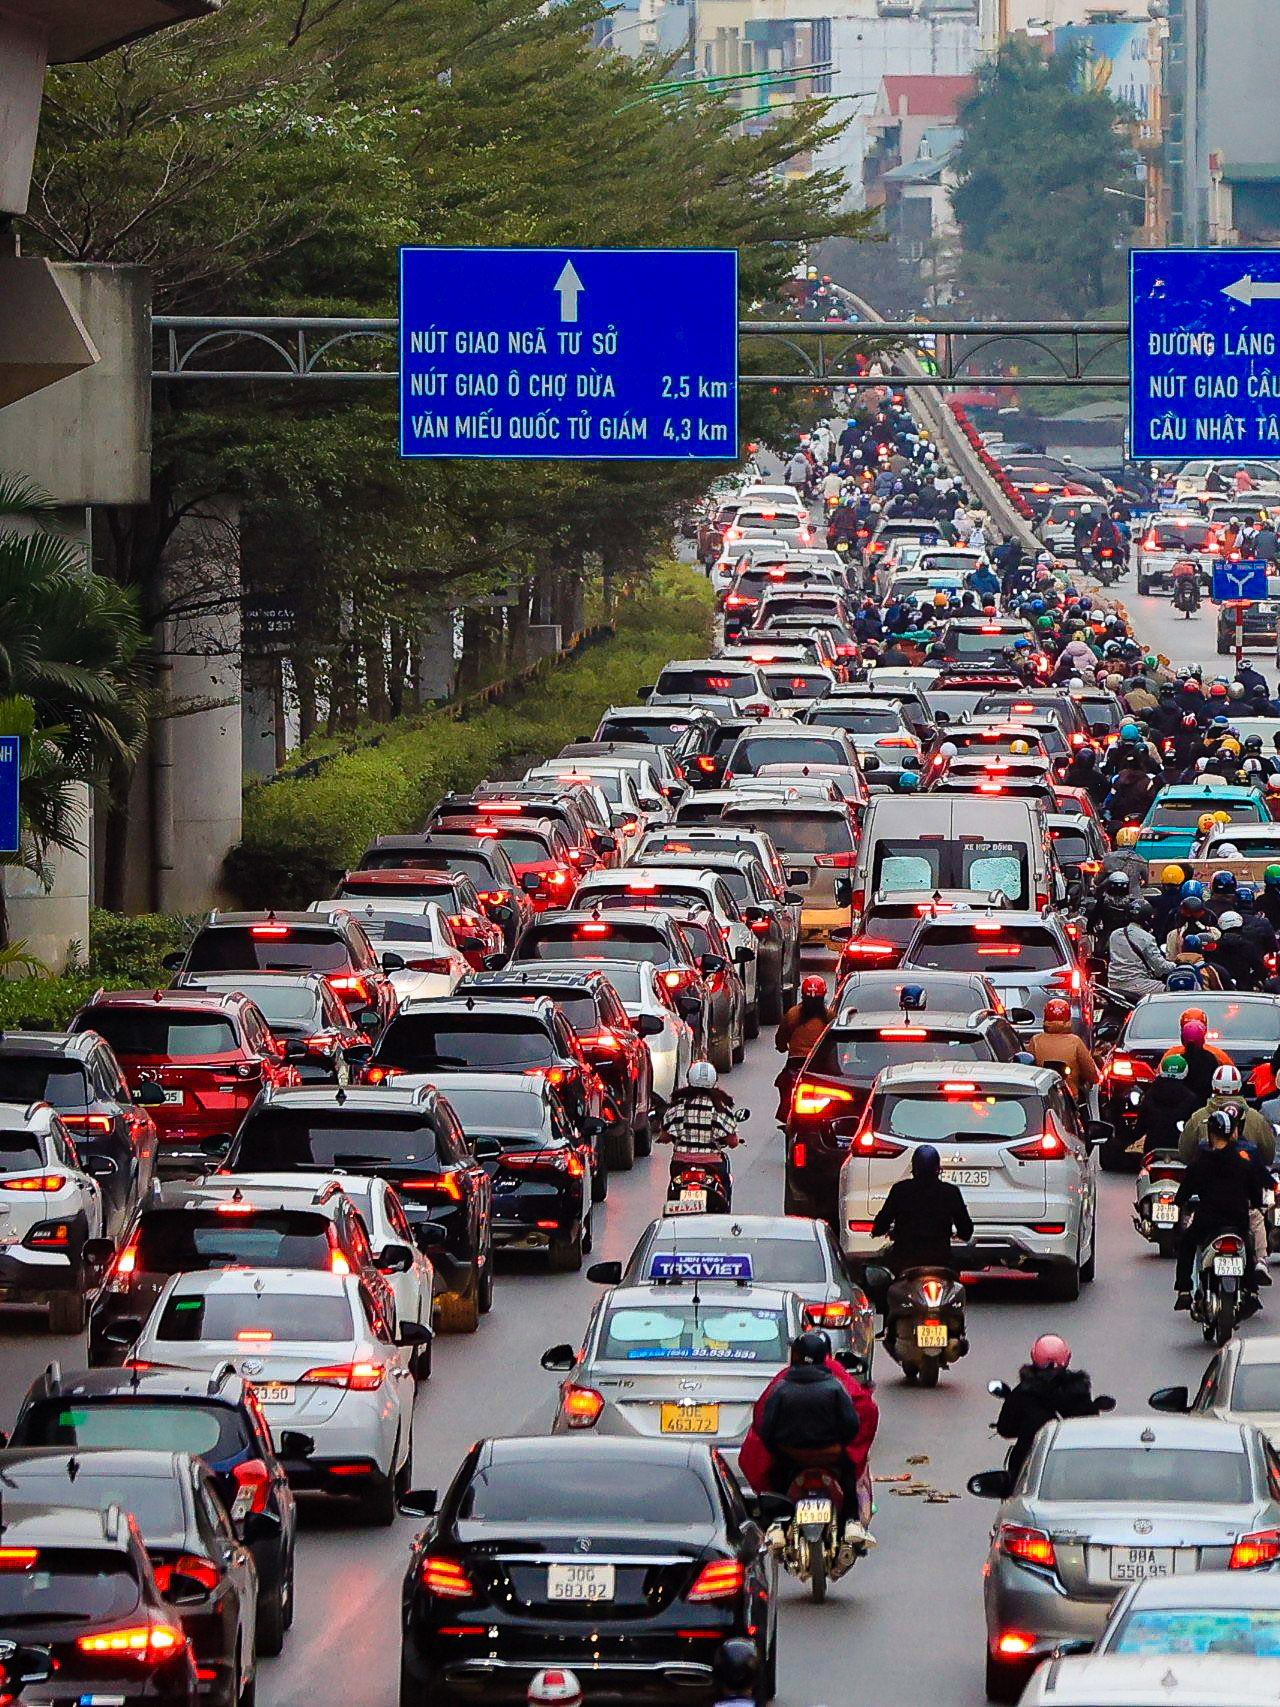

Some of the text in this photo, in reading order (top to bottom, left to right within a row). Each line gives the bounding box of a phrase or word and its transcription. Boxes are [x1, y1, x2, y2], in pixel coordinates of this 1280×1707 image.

[411, 324, 618, 354] NÚT GIAO NGÃ TƯ SỞ
[1148, 325, 1216, 355] ĐƯỜNG
[1224, 325, 1275, 355] LÁNG
[411, 366, 727, 401] NÚT GIAO Ô CHỢ DỪA 2,5 km
[1149, 368, 1187, 398] NÚT
[1194, 375, 1239, 398] GIAO
[411, 408, 728, 442] VĂN MIẾU QUỐC TỬ GIÁM 4,3 km
[1149, 410, 1187, 441] CẦU
[1195, 412, 1246, 444] NHẬT
